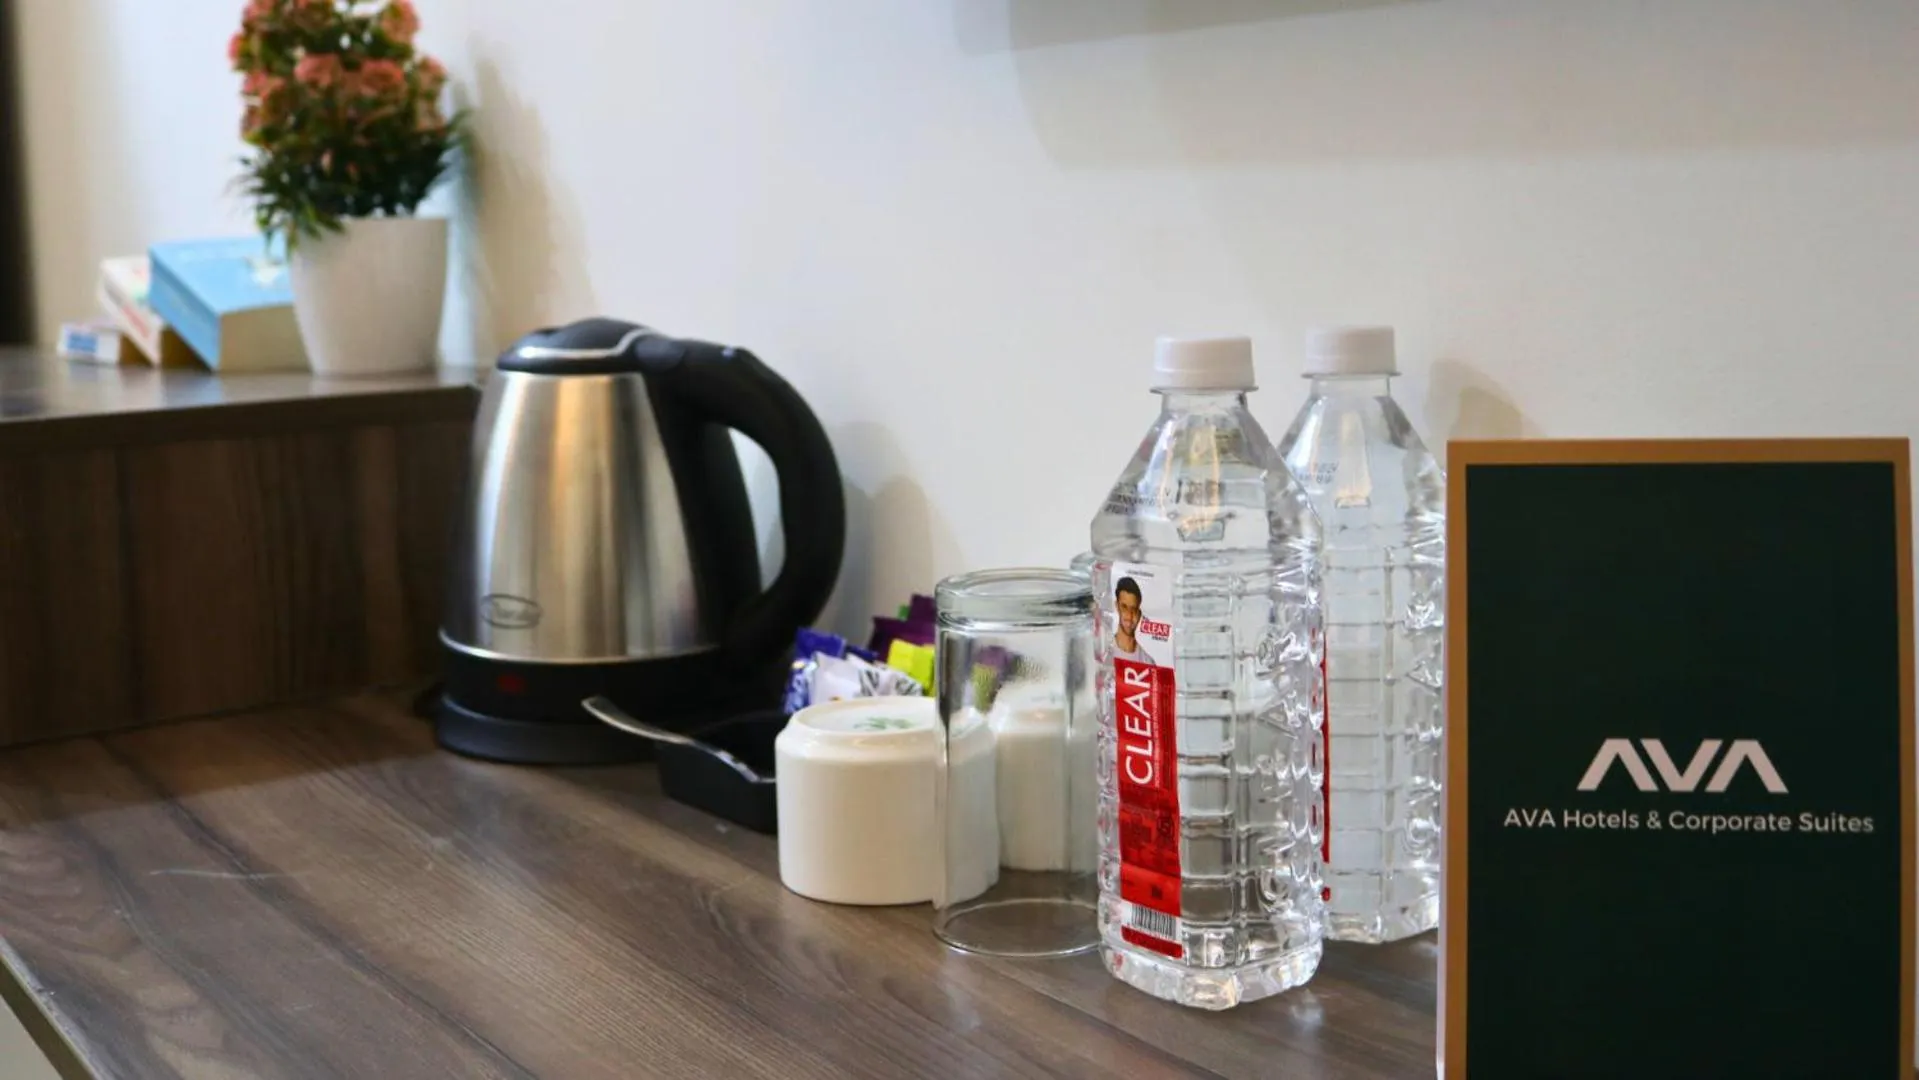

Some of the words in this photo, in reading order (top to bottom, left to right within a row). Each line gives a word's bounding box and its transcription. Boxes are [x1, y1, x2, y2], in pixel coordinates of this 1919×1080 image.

[1142, 622, 1169, 635] CLEAR
[1124, 667, 1153, 784] CLEAR
[1577, 738, 1789, 794] AVA
[1504, 809, 1556, 828] AVA
[1563, 809, 1639, 829] Hotels
[1647, 811, 1662, 829] &
[1668, 811, 1791, 835] Corporate
[1799, 812, 1874, 832] Suites
